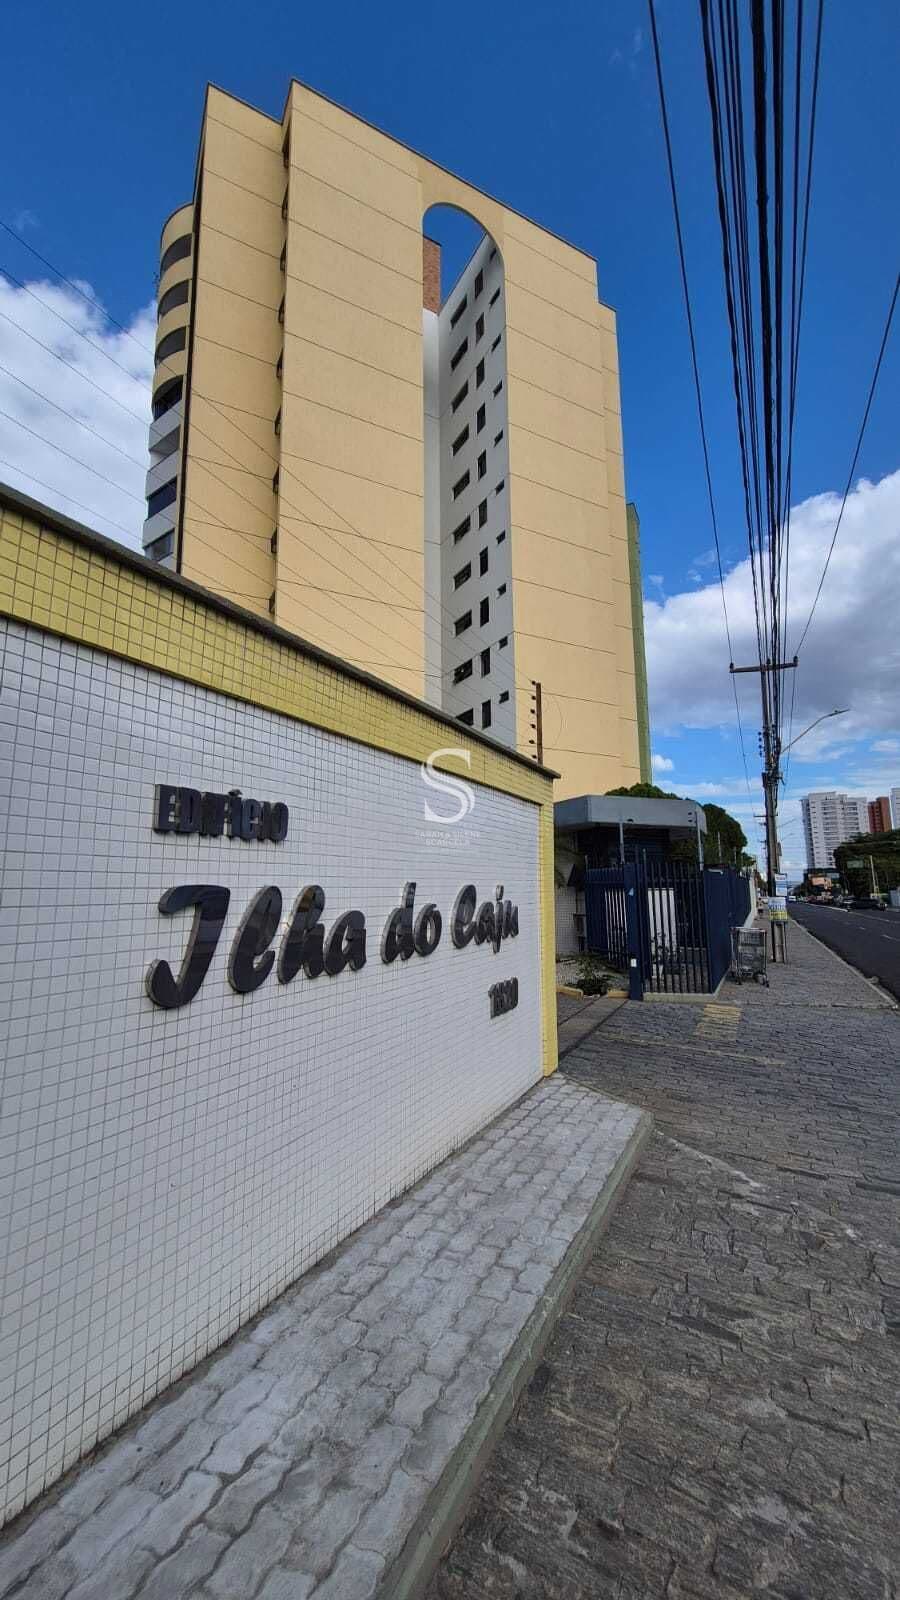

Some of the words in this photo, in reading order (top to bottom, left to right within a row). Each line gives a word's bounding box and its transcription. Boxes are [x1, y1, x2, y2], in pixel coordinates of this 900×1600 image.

[153, 784, 289, 842] EDIFÍCIO
[146, 884, 367, 1008] Ilha
[380, 881, 442, 964] do
[450, 884, 519, 954] Caju
